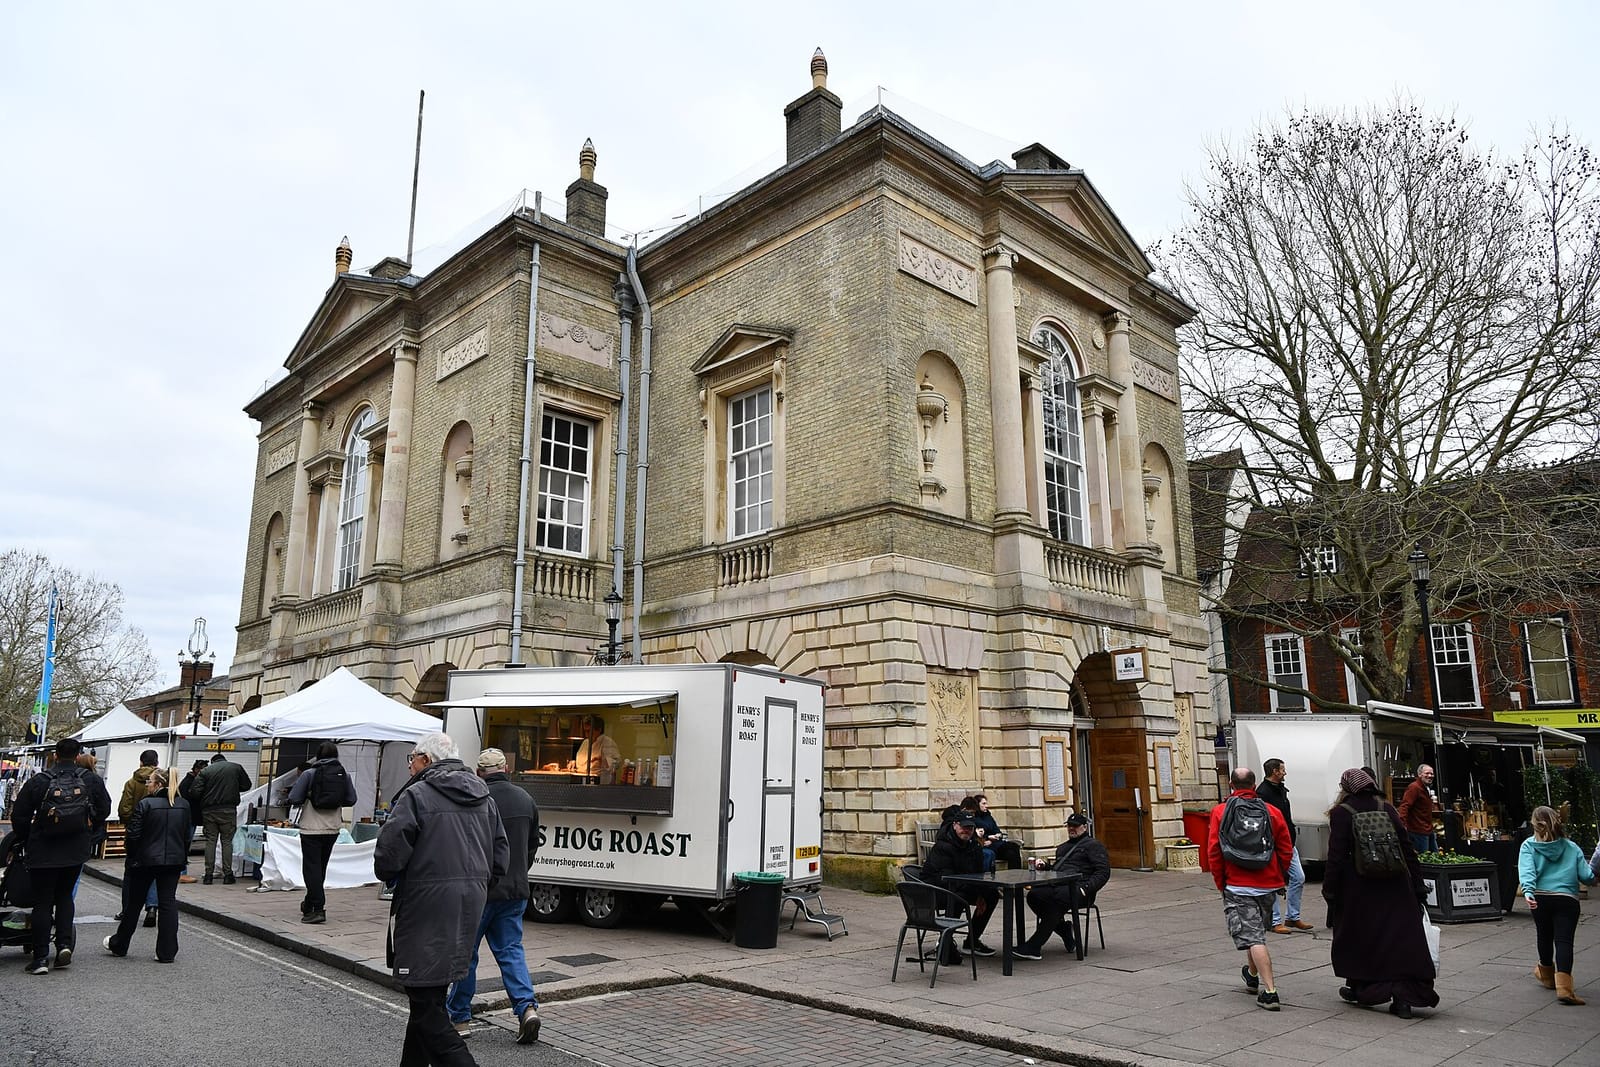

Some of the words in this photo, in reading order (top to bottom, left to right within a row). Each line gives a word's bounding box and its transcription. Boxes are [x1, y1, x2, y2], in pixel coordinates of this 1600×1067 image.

[737, 705, 760, 716] HENRY'S
[742, 718, 755, 728] HOG
[801, 713, 819, 723] HENRY'S
[805, 725, 815, 734] HOG
[739, 731, 757, 741] ROAST
[802, 737, 817, 745] ROAST
[553, 826, 602, 851] HOG
[609, 829, 691, 858] ROAST
